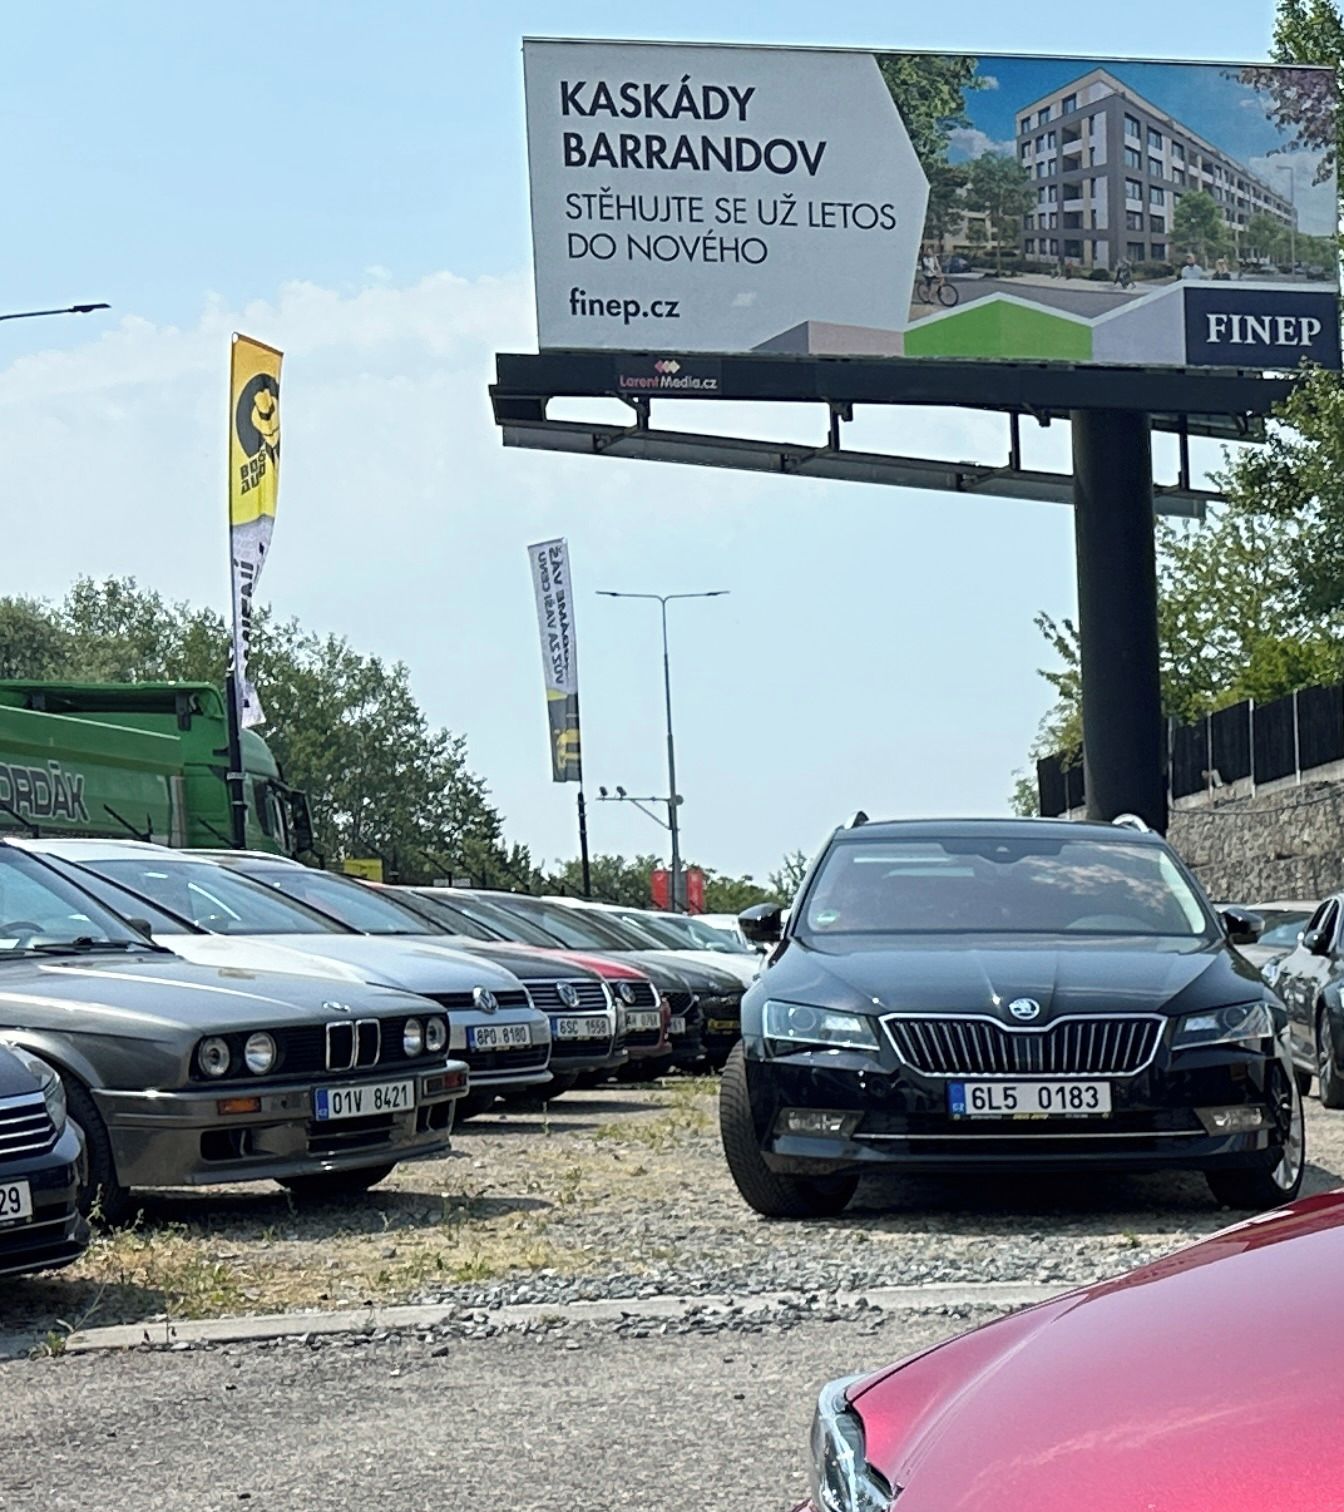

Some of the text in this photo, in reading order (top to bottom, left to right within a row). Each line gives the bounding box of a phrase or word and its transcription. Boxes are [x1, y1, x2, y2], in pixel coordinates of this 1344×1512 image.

[560, 74, 756, 121] KASKÁDY
[563, 131, 827, 176] BARRANDOV
[565, 186, 897, 231] STĚHUJTE SE UŽ LETOS
[567, 229, 768, 265] DO NOVÉHO
[569, 287, 681, 325] finep.cz
[1206, 313, 1321, 347] FINEP
[333, 1084, 407, 1114] 01V 8421
[971, 1086, 1018, 1110] 6L5
[1038, 1085, 1099, 1110] 0183
